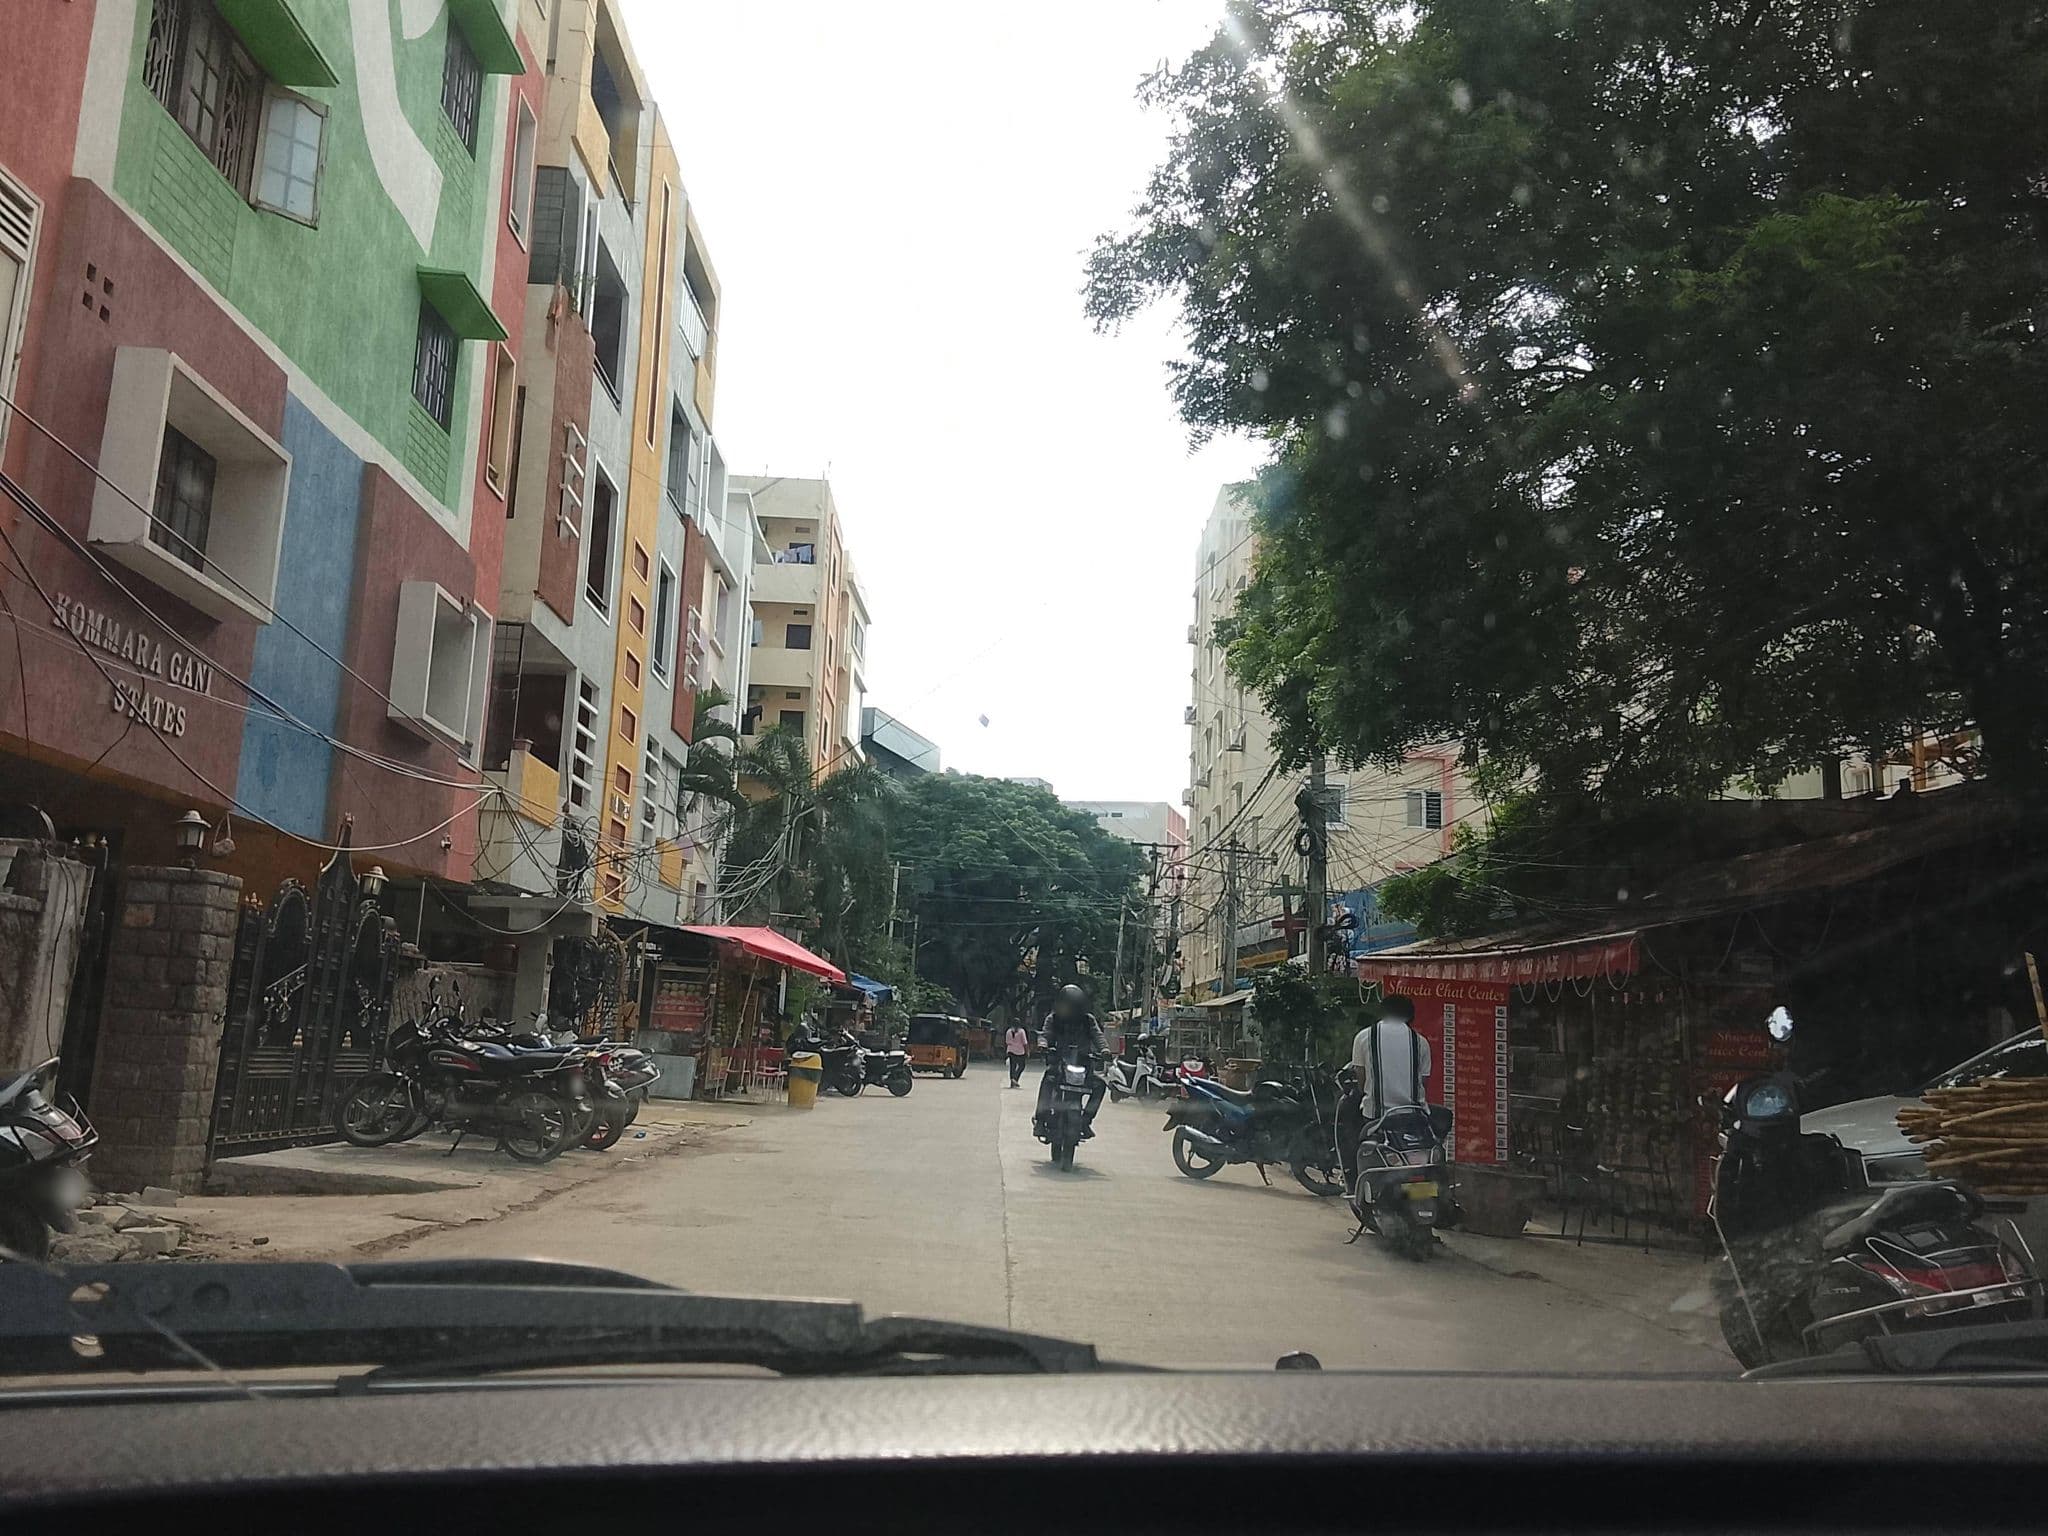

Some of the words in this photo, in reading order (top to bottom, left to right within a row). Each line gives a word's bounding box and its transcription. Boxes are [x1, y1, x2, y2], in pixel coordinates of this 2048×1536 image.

[53, 592, 162, 674] KOMMARA
[113, 679, 188, 737] STATES
[1388, 979, 1432, 996] Shweta
[1435, 982, 1465, 999] Chat
